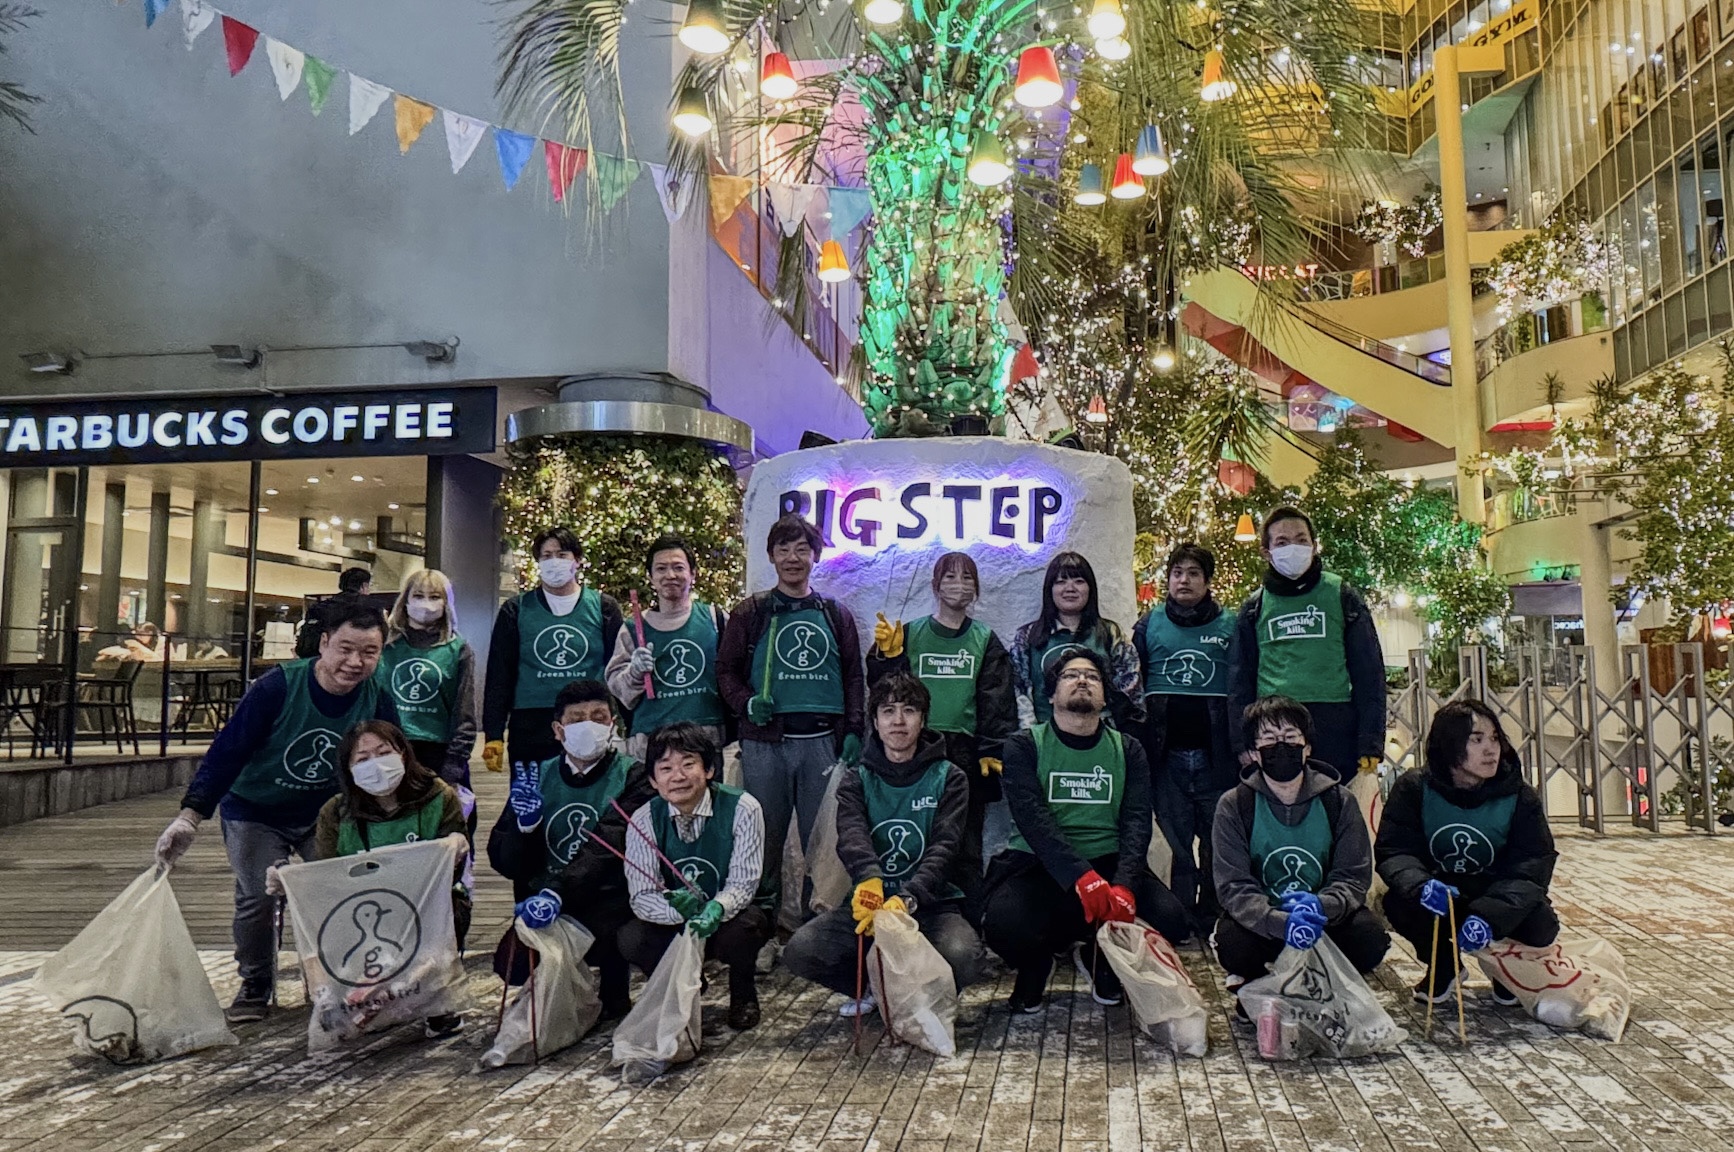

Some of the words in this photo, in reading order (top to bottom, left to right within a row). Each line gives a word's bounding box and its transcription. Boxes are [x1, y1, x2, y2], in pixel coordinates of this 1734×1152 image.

[260, 402, 453, 444] COFFEE
[897, 483, 1063, 544] STEP
[1277, 616, 1315, 629] Smoking
[928, 657, 965, 668] Smoking
[778, 671, 807, 680] green
[809, 672, 829, 680] bird
[657, 689, 686, 699] green
[687, 687, 707, 695] bird
[1060, 777, 1102, 791] Smoking
[364, 946, 383, 978] g
